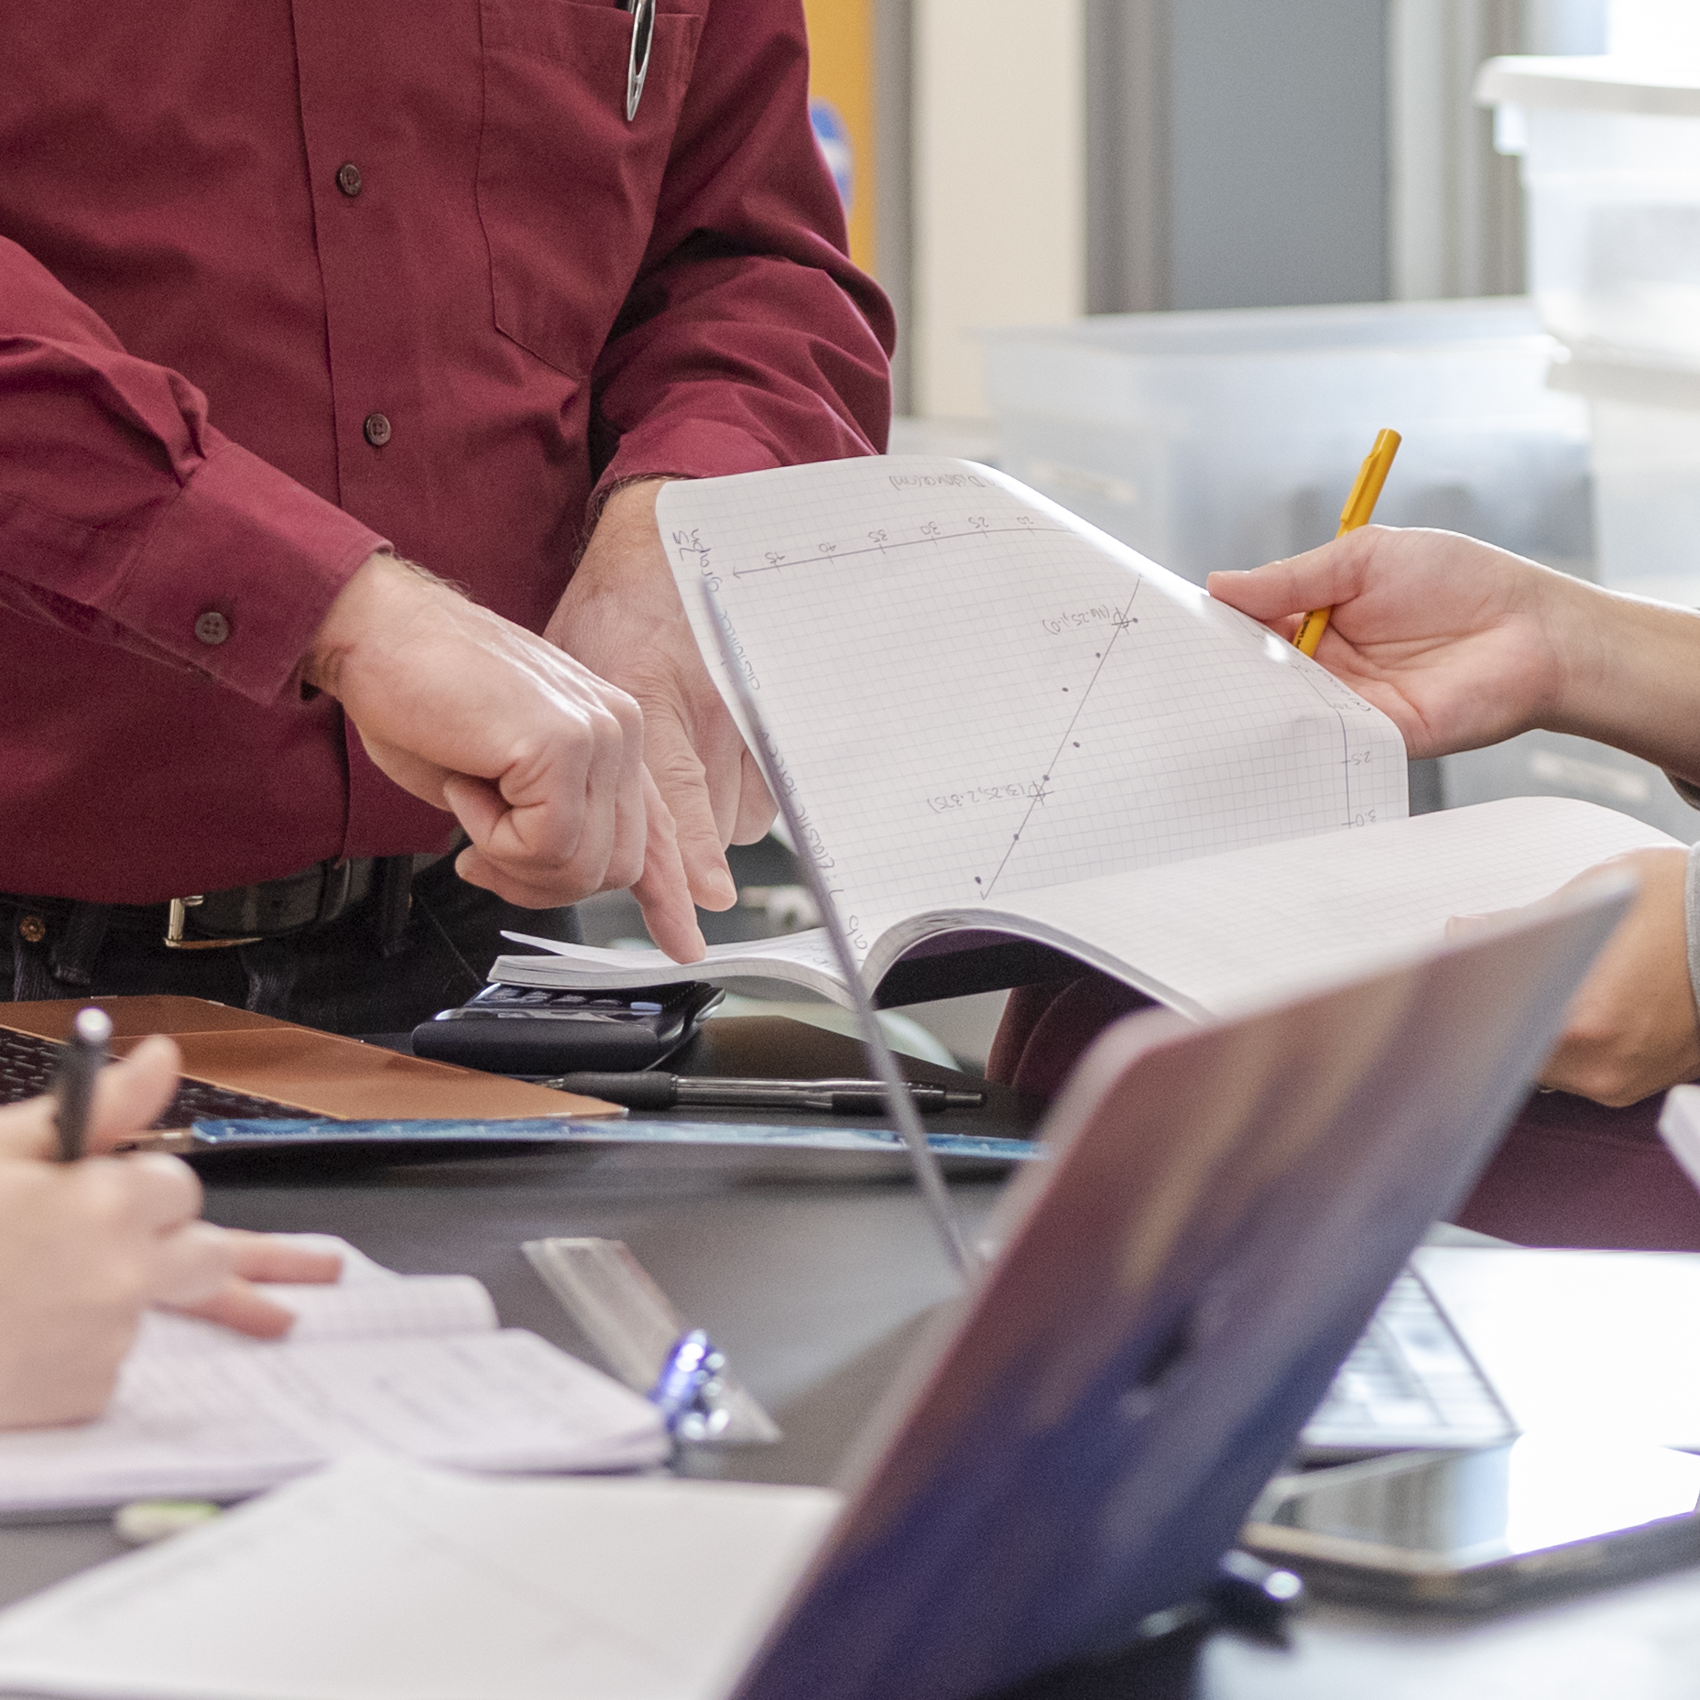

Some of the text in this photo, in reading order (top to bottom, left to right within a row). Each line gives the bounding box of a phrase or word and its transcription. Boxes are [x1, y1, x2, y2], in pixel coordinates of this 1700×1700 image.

[818, 541, 838, 556] 40
[867, 528, 889, 544] 35
[919, 521, 942, 536] 30
[967, 516, 990, 530] 25
[688, 526, 723, 596] graph
[1350, 750, 1372, 767] 2.5
[1355, 808, 1377, 828] 3.0
